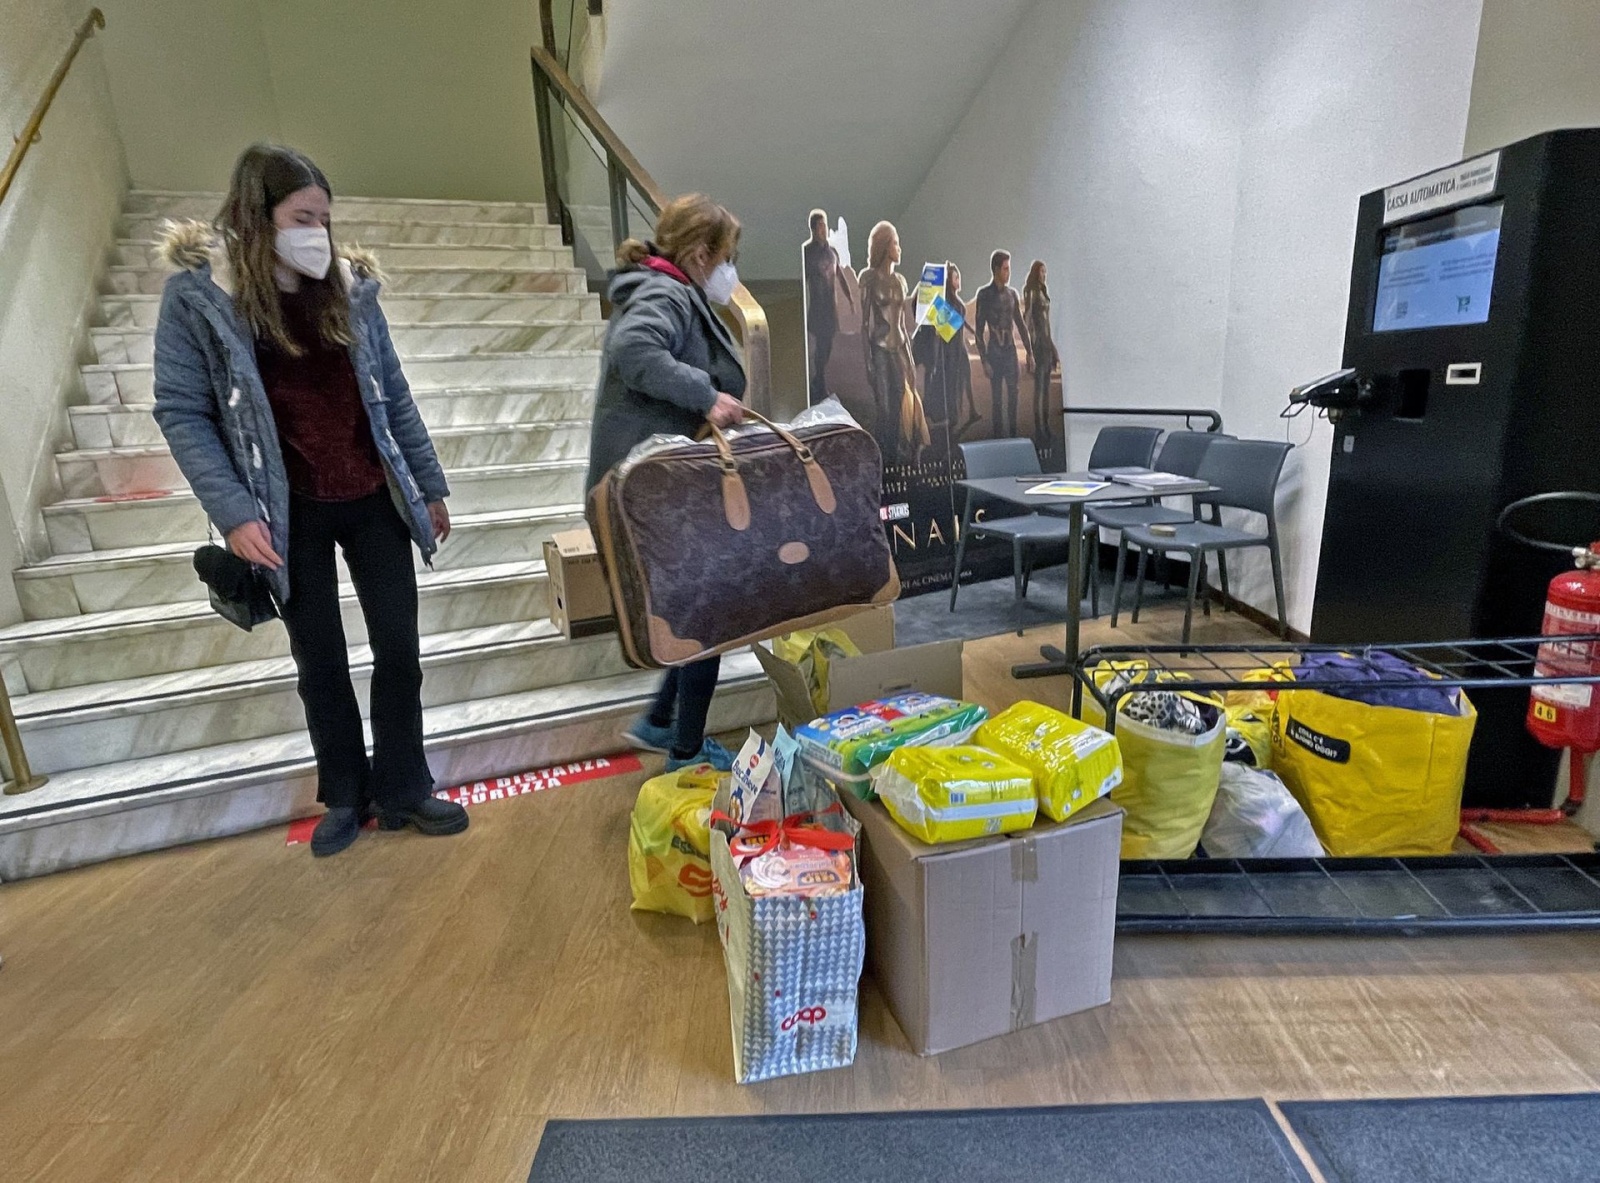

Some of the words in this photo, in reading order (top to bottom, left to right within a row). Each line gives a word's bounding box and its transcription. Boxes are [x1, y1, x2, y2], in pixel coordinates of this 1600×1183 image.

[1387, 192, 1408, 212] CASSA
[1410, 178, 1456, 204] AUTOMATICA
[454, 778, 562, 808] CUREZZA
[459, 782, 488, 797] LA
[497, 758, 611, 788] DISTANZA
[781, 1006, 827, 1031] coop
